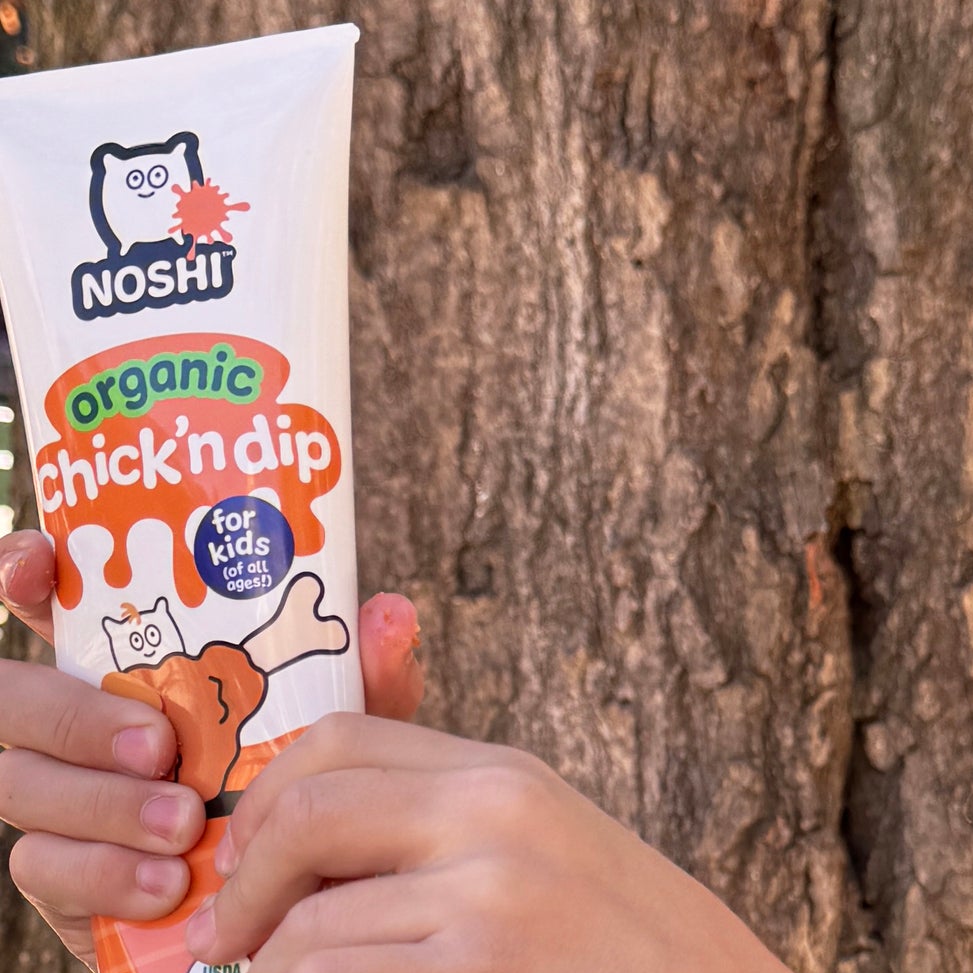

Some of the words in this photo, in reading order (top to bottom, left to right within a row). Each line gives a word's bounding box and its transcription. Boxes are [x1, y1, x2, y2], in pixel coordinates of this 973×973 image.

[81, 252, 223, 310] NOSHI
[71, 350, 256, 424] organic
[37, 415, 226, 513] chick’n
[234, 413, 332, 484] dip
[211, 508, 256, 534] for
[208, 530, 271, 566] kids
[223, 561, 244, 580] (of
[247, 560, 269, 573] all
[227, 574, 272, 592] ages!)
